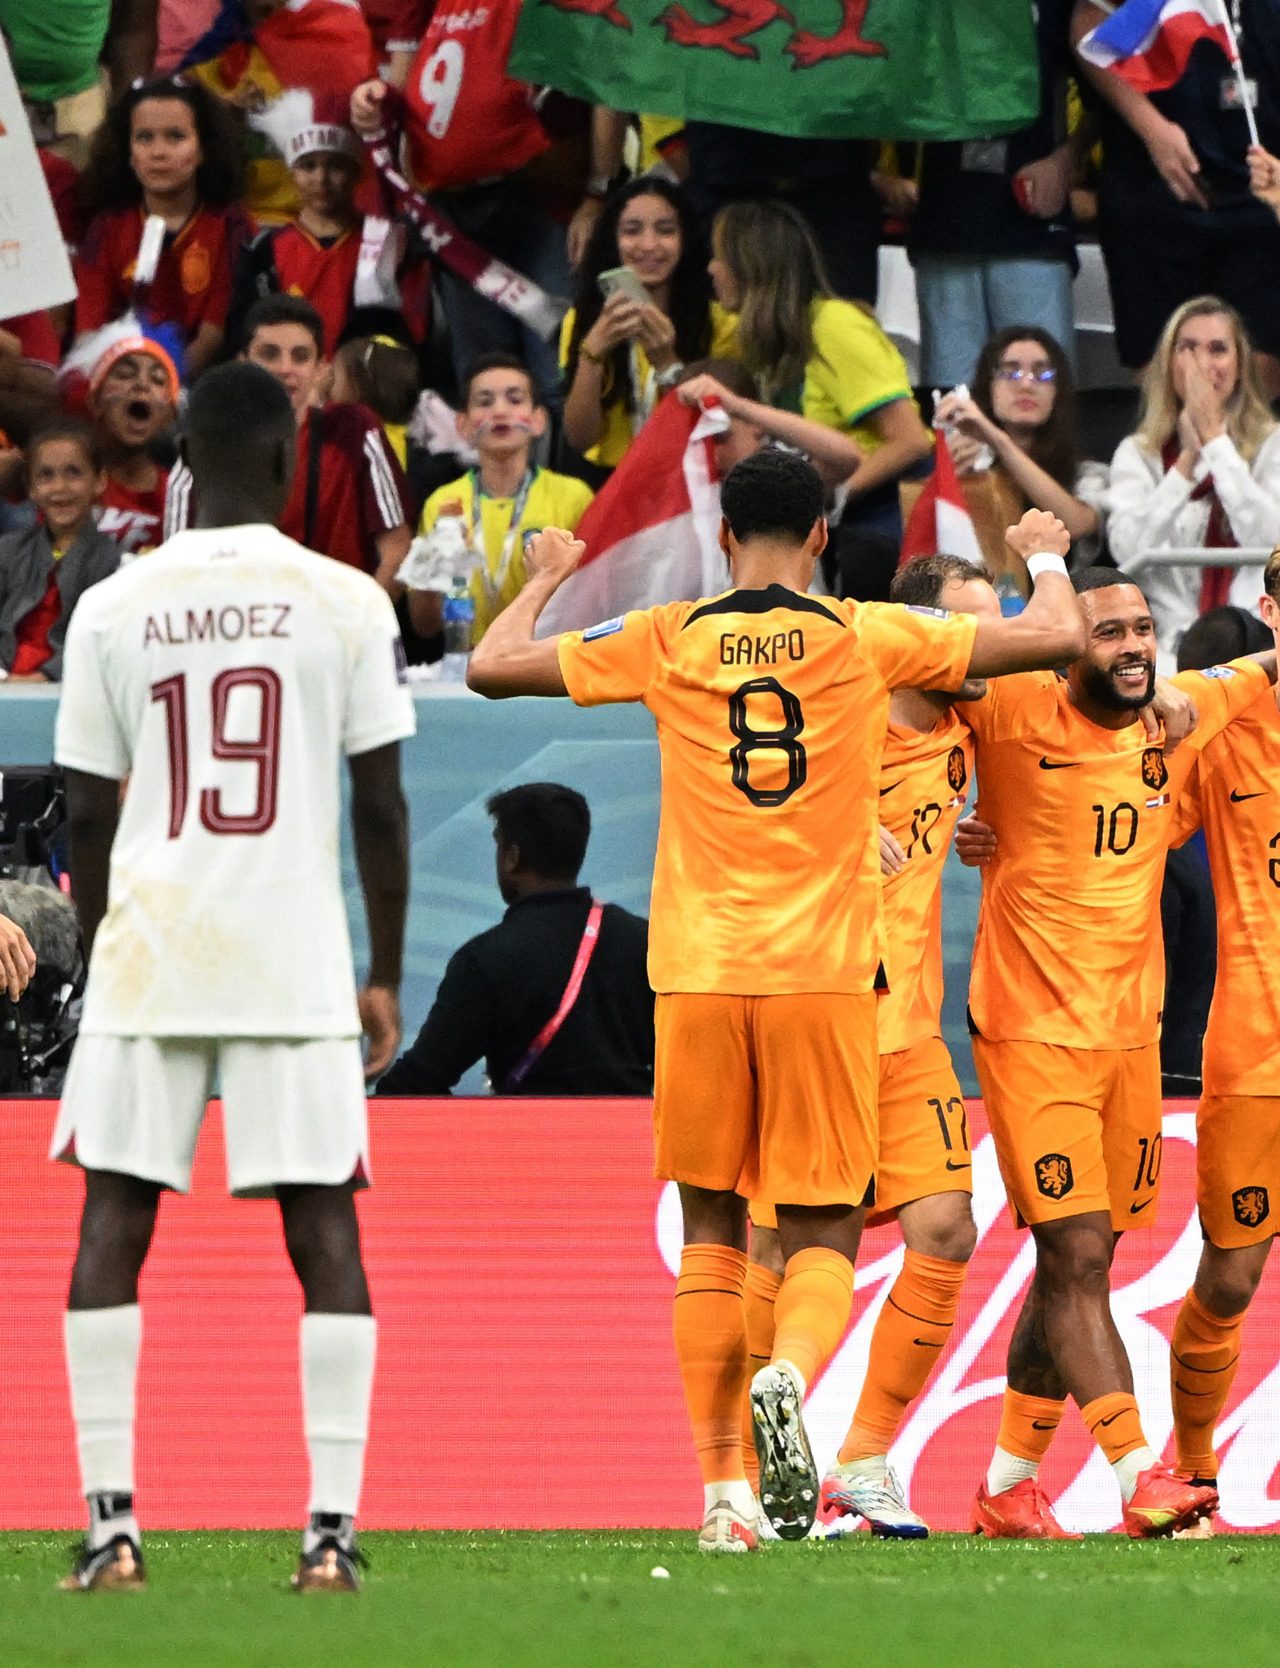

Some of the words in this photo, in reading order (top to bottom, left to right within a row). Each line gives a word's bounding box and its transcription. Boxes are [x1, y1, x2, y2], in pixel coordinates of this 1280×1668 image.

[419, 39, 465, 139] 9
[143, 603, 291, 648] ALMOEZ
[720, 628, 805, 665] GAKPO
[151, 665, 283, 840] 19
[728, 676, 807, 808] 8
[906, 802, 942, 859] 17
[1092, 801, 1138, 858] 10
[928, 1097, 969, 1151] 17
[1133, 1132, 1163, 1191] 10
